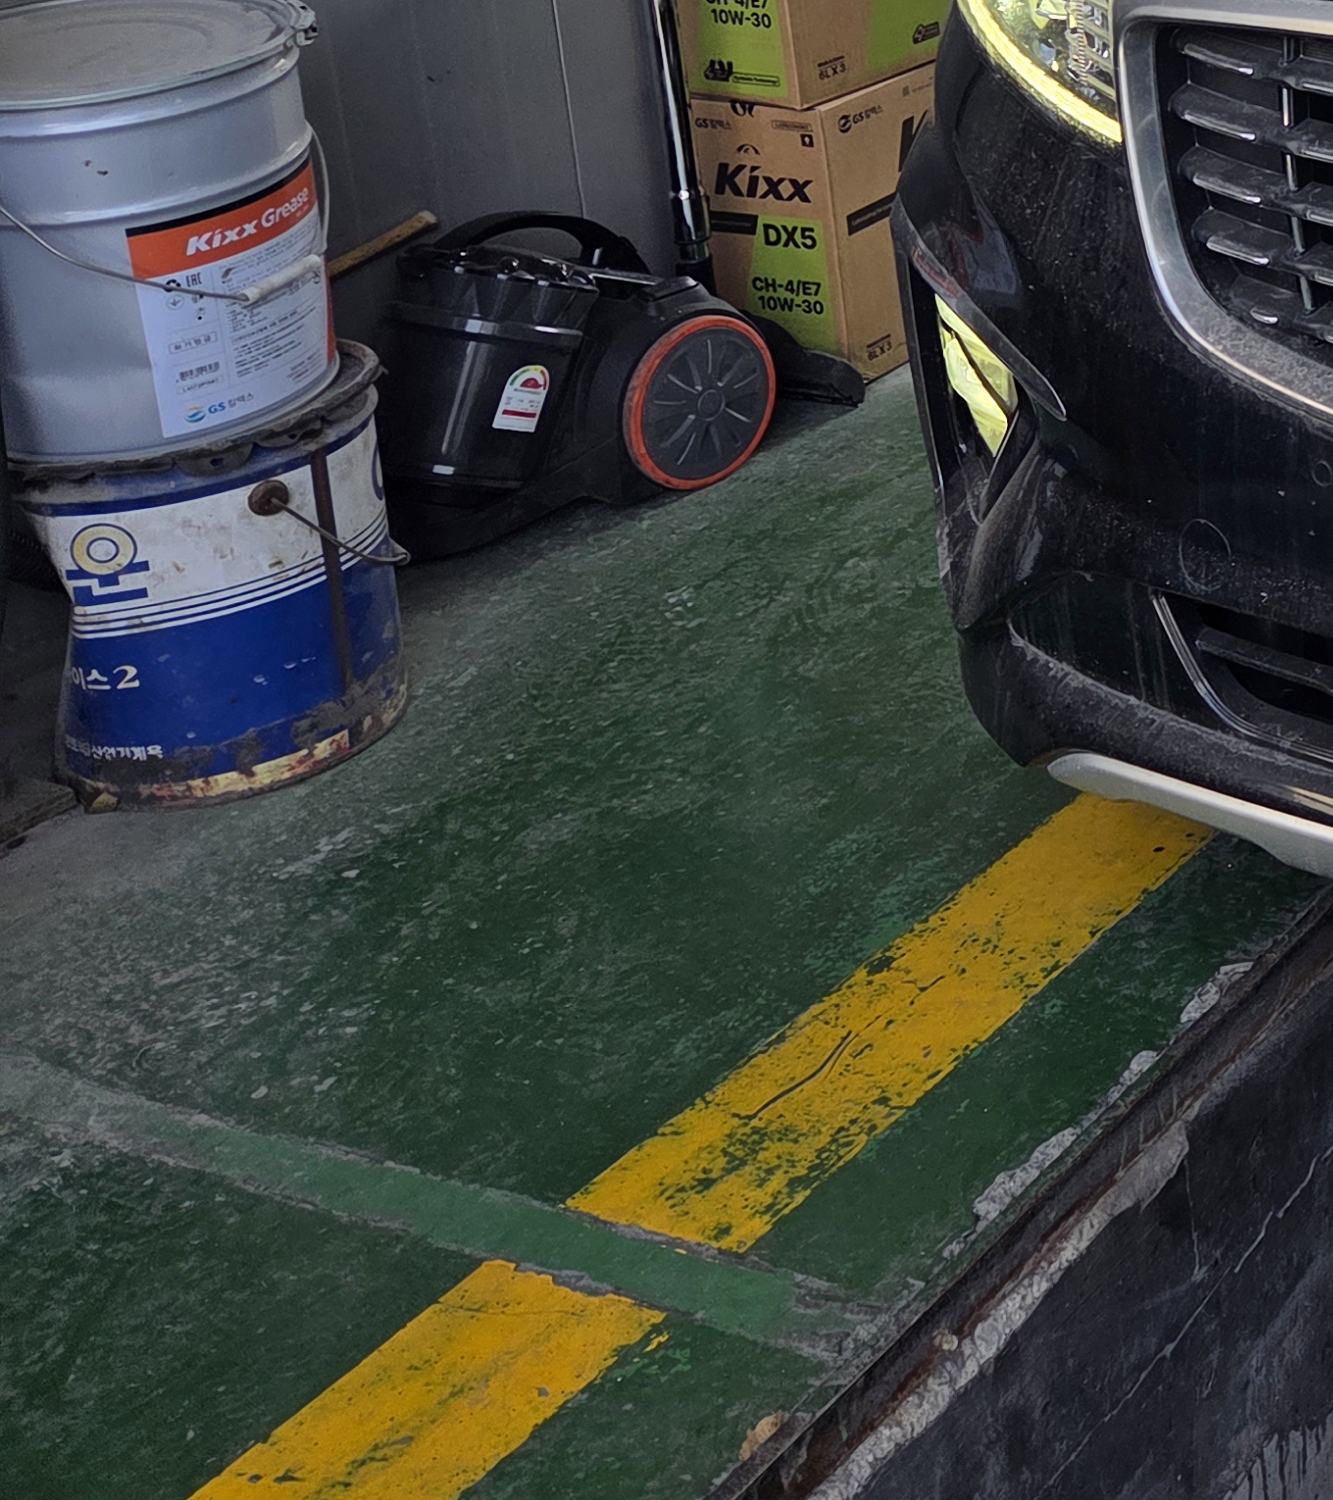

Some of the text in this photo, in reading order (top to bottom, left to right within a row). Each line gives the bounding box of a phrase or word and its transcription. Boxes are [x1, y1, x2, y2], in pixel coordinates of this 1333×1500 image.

[709, 8, 773, 29] 10W-30
[714, 160, 814, 205] Kixx
[185, 186, 309, 257] Kixx Grease
[761, 222, 818, 251] DX5
[751, 276, 823, 298] CH-4/E7
[757, 296, 825, 316] 10W-30
